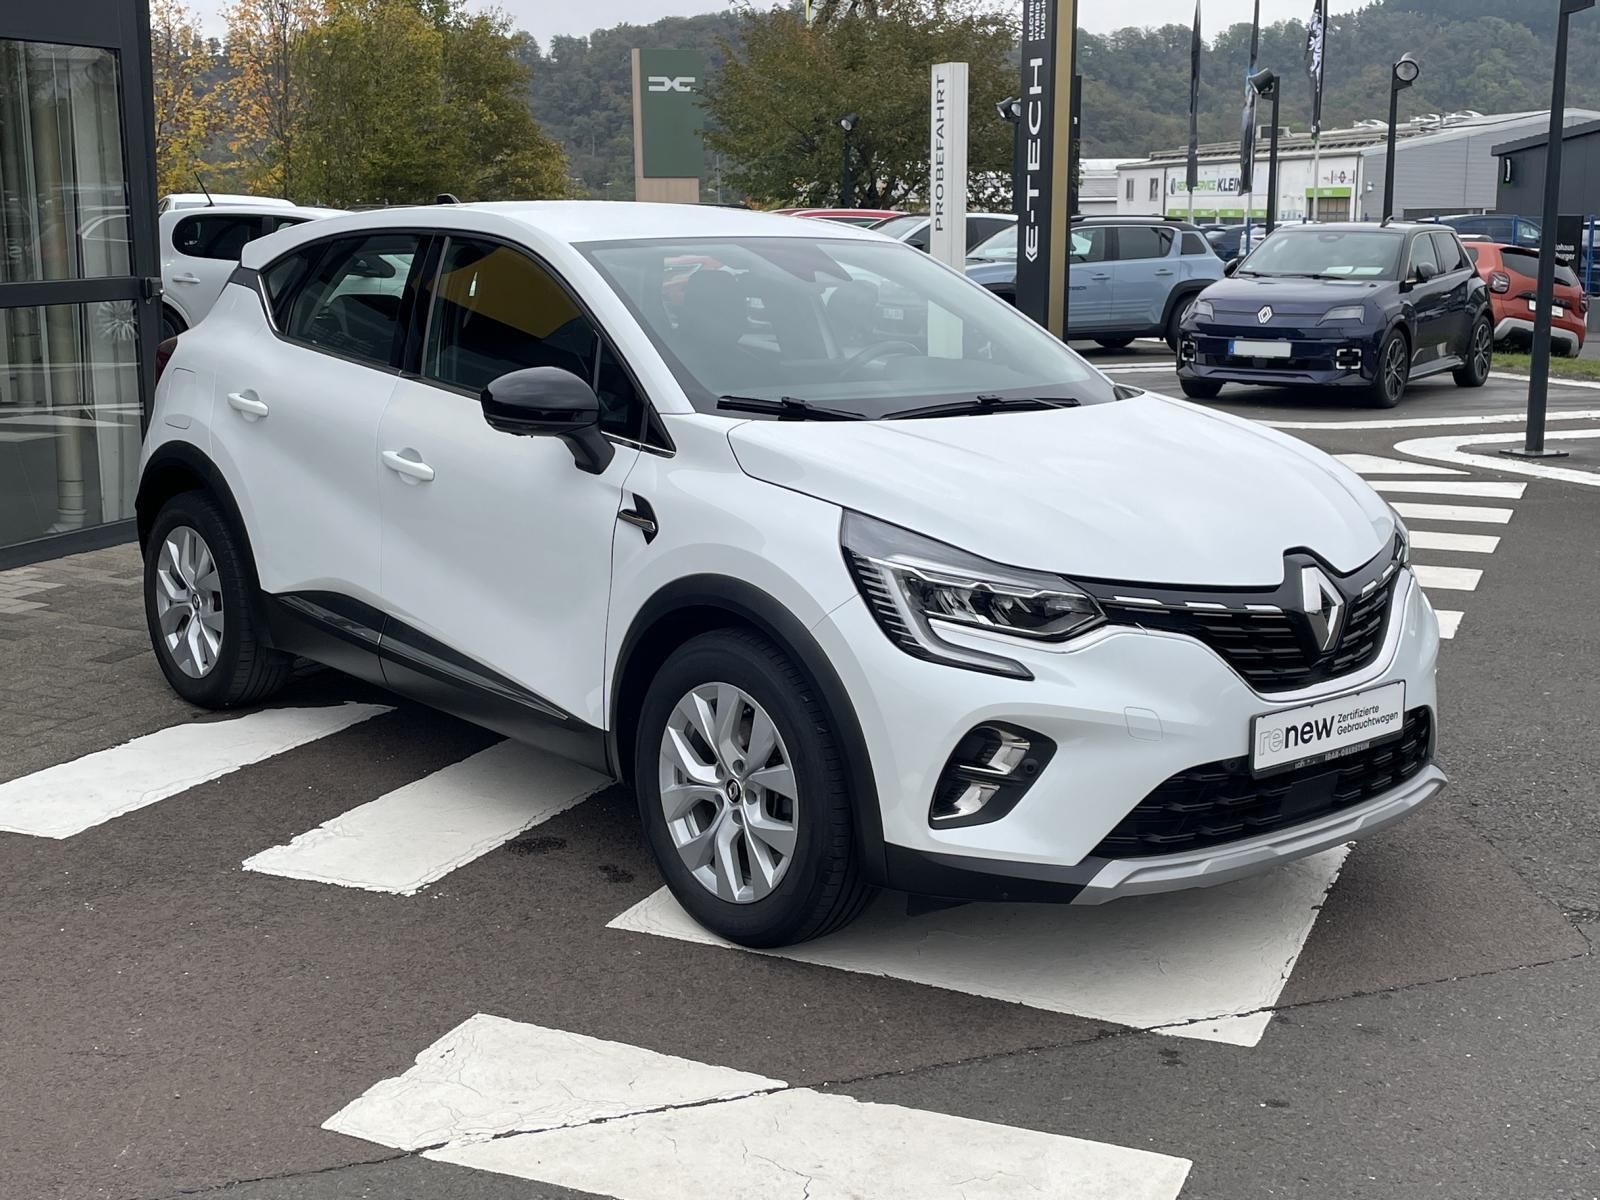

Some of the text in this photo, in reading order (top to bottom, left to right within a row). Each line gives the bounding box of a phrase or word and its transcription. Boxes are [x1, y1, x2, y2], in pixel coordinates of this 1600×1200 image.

[935, 74, 945, 232] PROBEFAHRT
[1025, 57, 1043, 263] E-TECH
[1337, 705, 1379, 723] Zertifizierte
[1337, 711, 1398, 735] Gebrauchtwagen
[1259, 716, 1335, 756] renew
